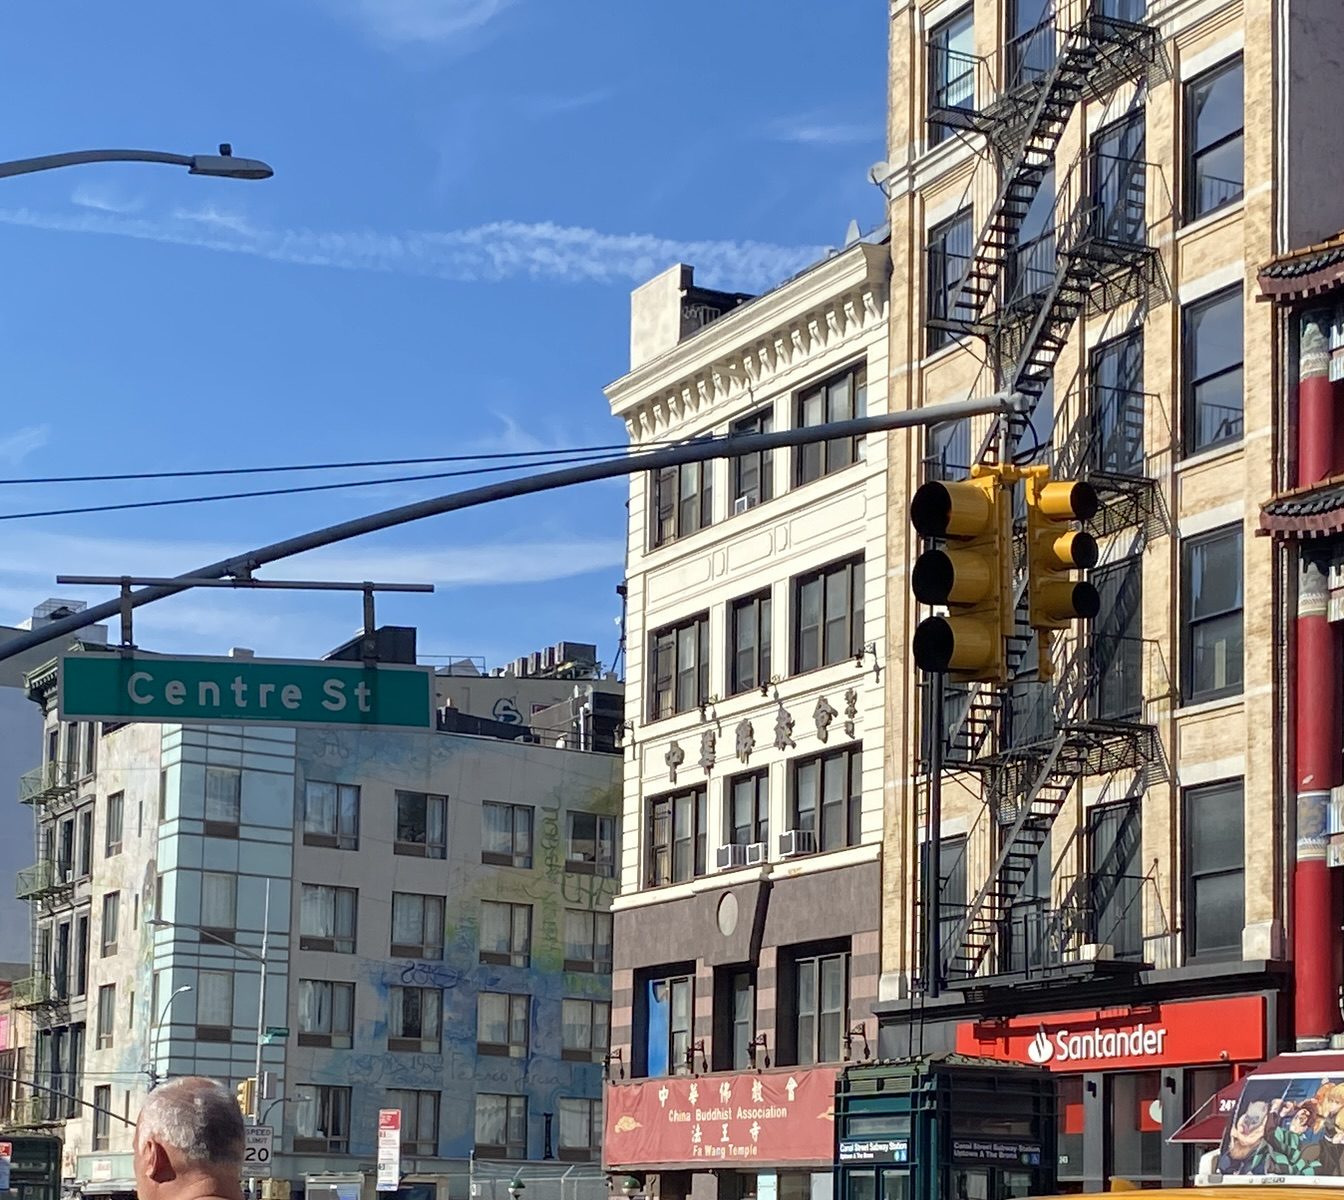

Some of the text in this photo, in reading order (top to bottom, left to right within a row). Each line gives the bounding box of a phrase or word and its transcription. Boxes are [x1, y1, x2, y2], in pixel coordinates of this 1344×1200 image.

[127, 671, 372, 713] Centre St
[1057, 1024, 1167, 1061] Santander
[669, 1106, 787, 1122] China Buddhist Association
[245, 1128, 271, 1136] SPEED
[693, 1144, 758, 1158] Fa Wang Temple
[840, 1141, 907, 1152] Canal Street Subway Station
[954, 1142, 972, 1150] Canal
[993, 1143, 1017, 1152] Subway
[1019, 1144, 1040, 1152] Station
[245, 1147, 269, 1162] 20
[954, 1150, 978, 1158] Uptown
